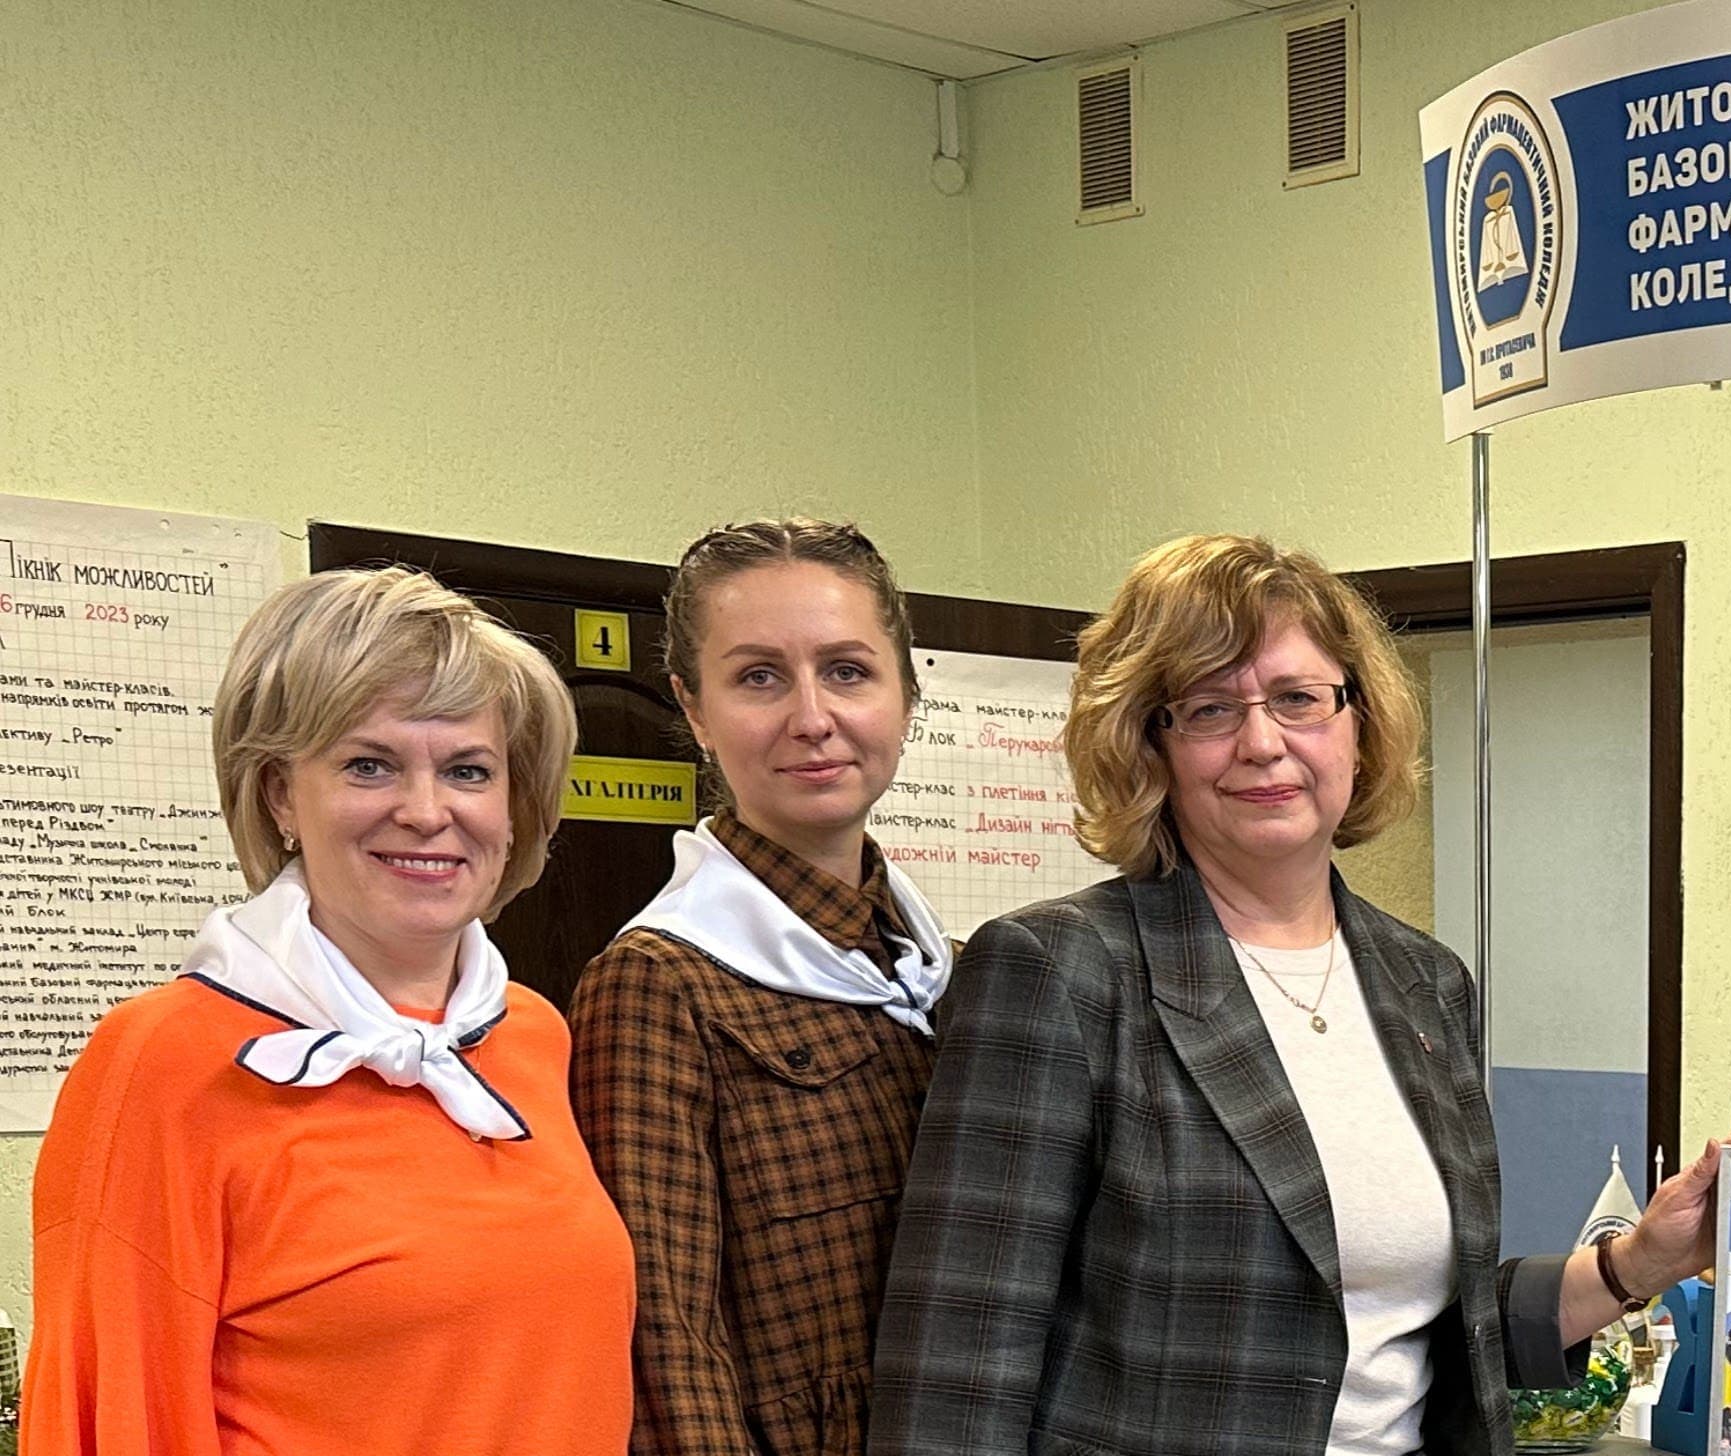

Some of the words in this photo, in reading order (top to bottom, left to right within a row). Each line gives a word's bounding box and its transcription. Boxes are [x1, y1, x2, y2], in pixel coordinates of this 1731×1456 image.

[1535, 222, 1553, 309] КОЛЕДЖ
[15, 602, 66, 619] грудня
[85, 603, 130, 624] 2023
[134, 613, 170, 631] року
[592, 626, 613, 656] 4
[35, 677, 55, 688] та
[124, 700, 189, 717] протягом
[982, 784, 1048, 802] плетіння
[80, 804, 105, 819] шоу
[2, 818, 44, 832] перед
[967, 848, 1042, 873] майстер
